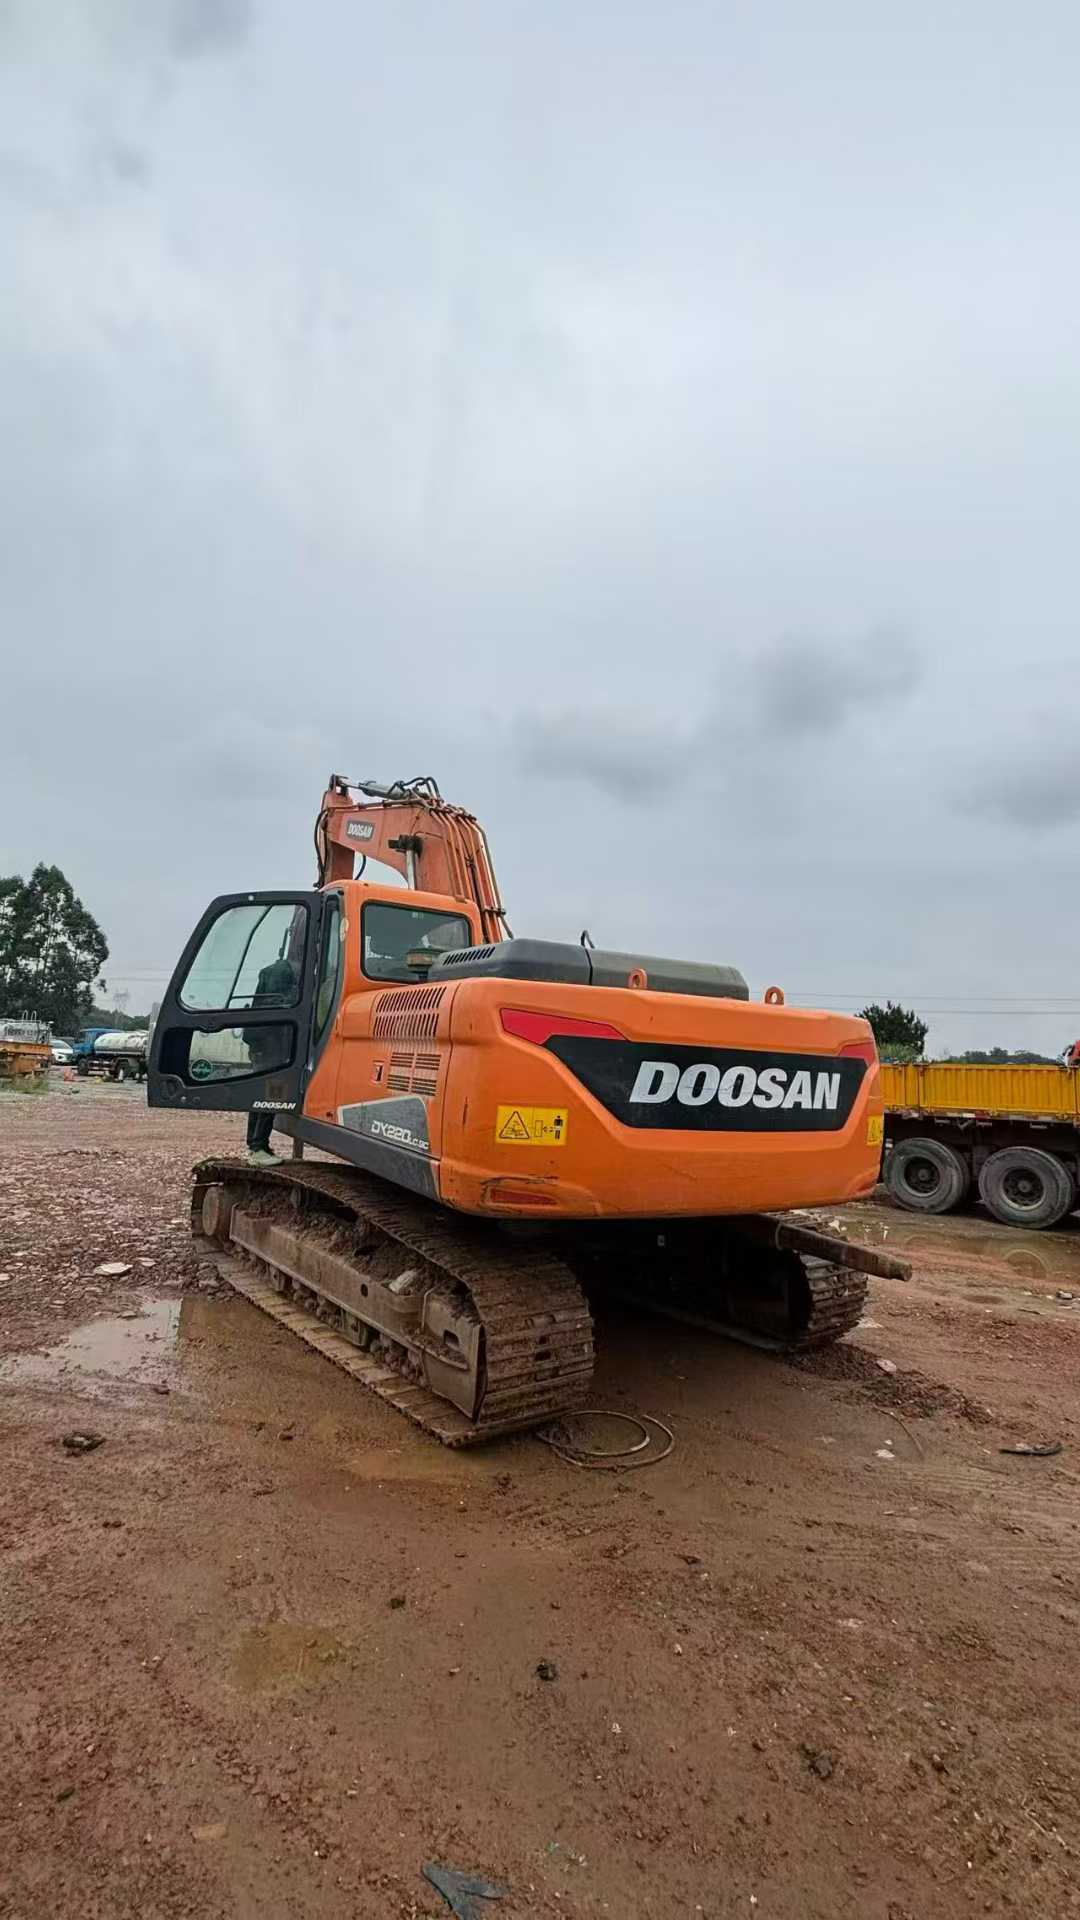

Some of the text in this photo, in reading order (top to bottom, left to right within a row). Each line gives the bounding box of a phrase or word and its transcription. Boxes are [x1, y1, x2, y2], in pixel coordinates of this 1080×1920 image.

[347, 823, 373, 838] DOOSAN
[629, 1060, 841, 1110] DOOSAN
[252, 1101, 297, 1110] DOOSAN
